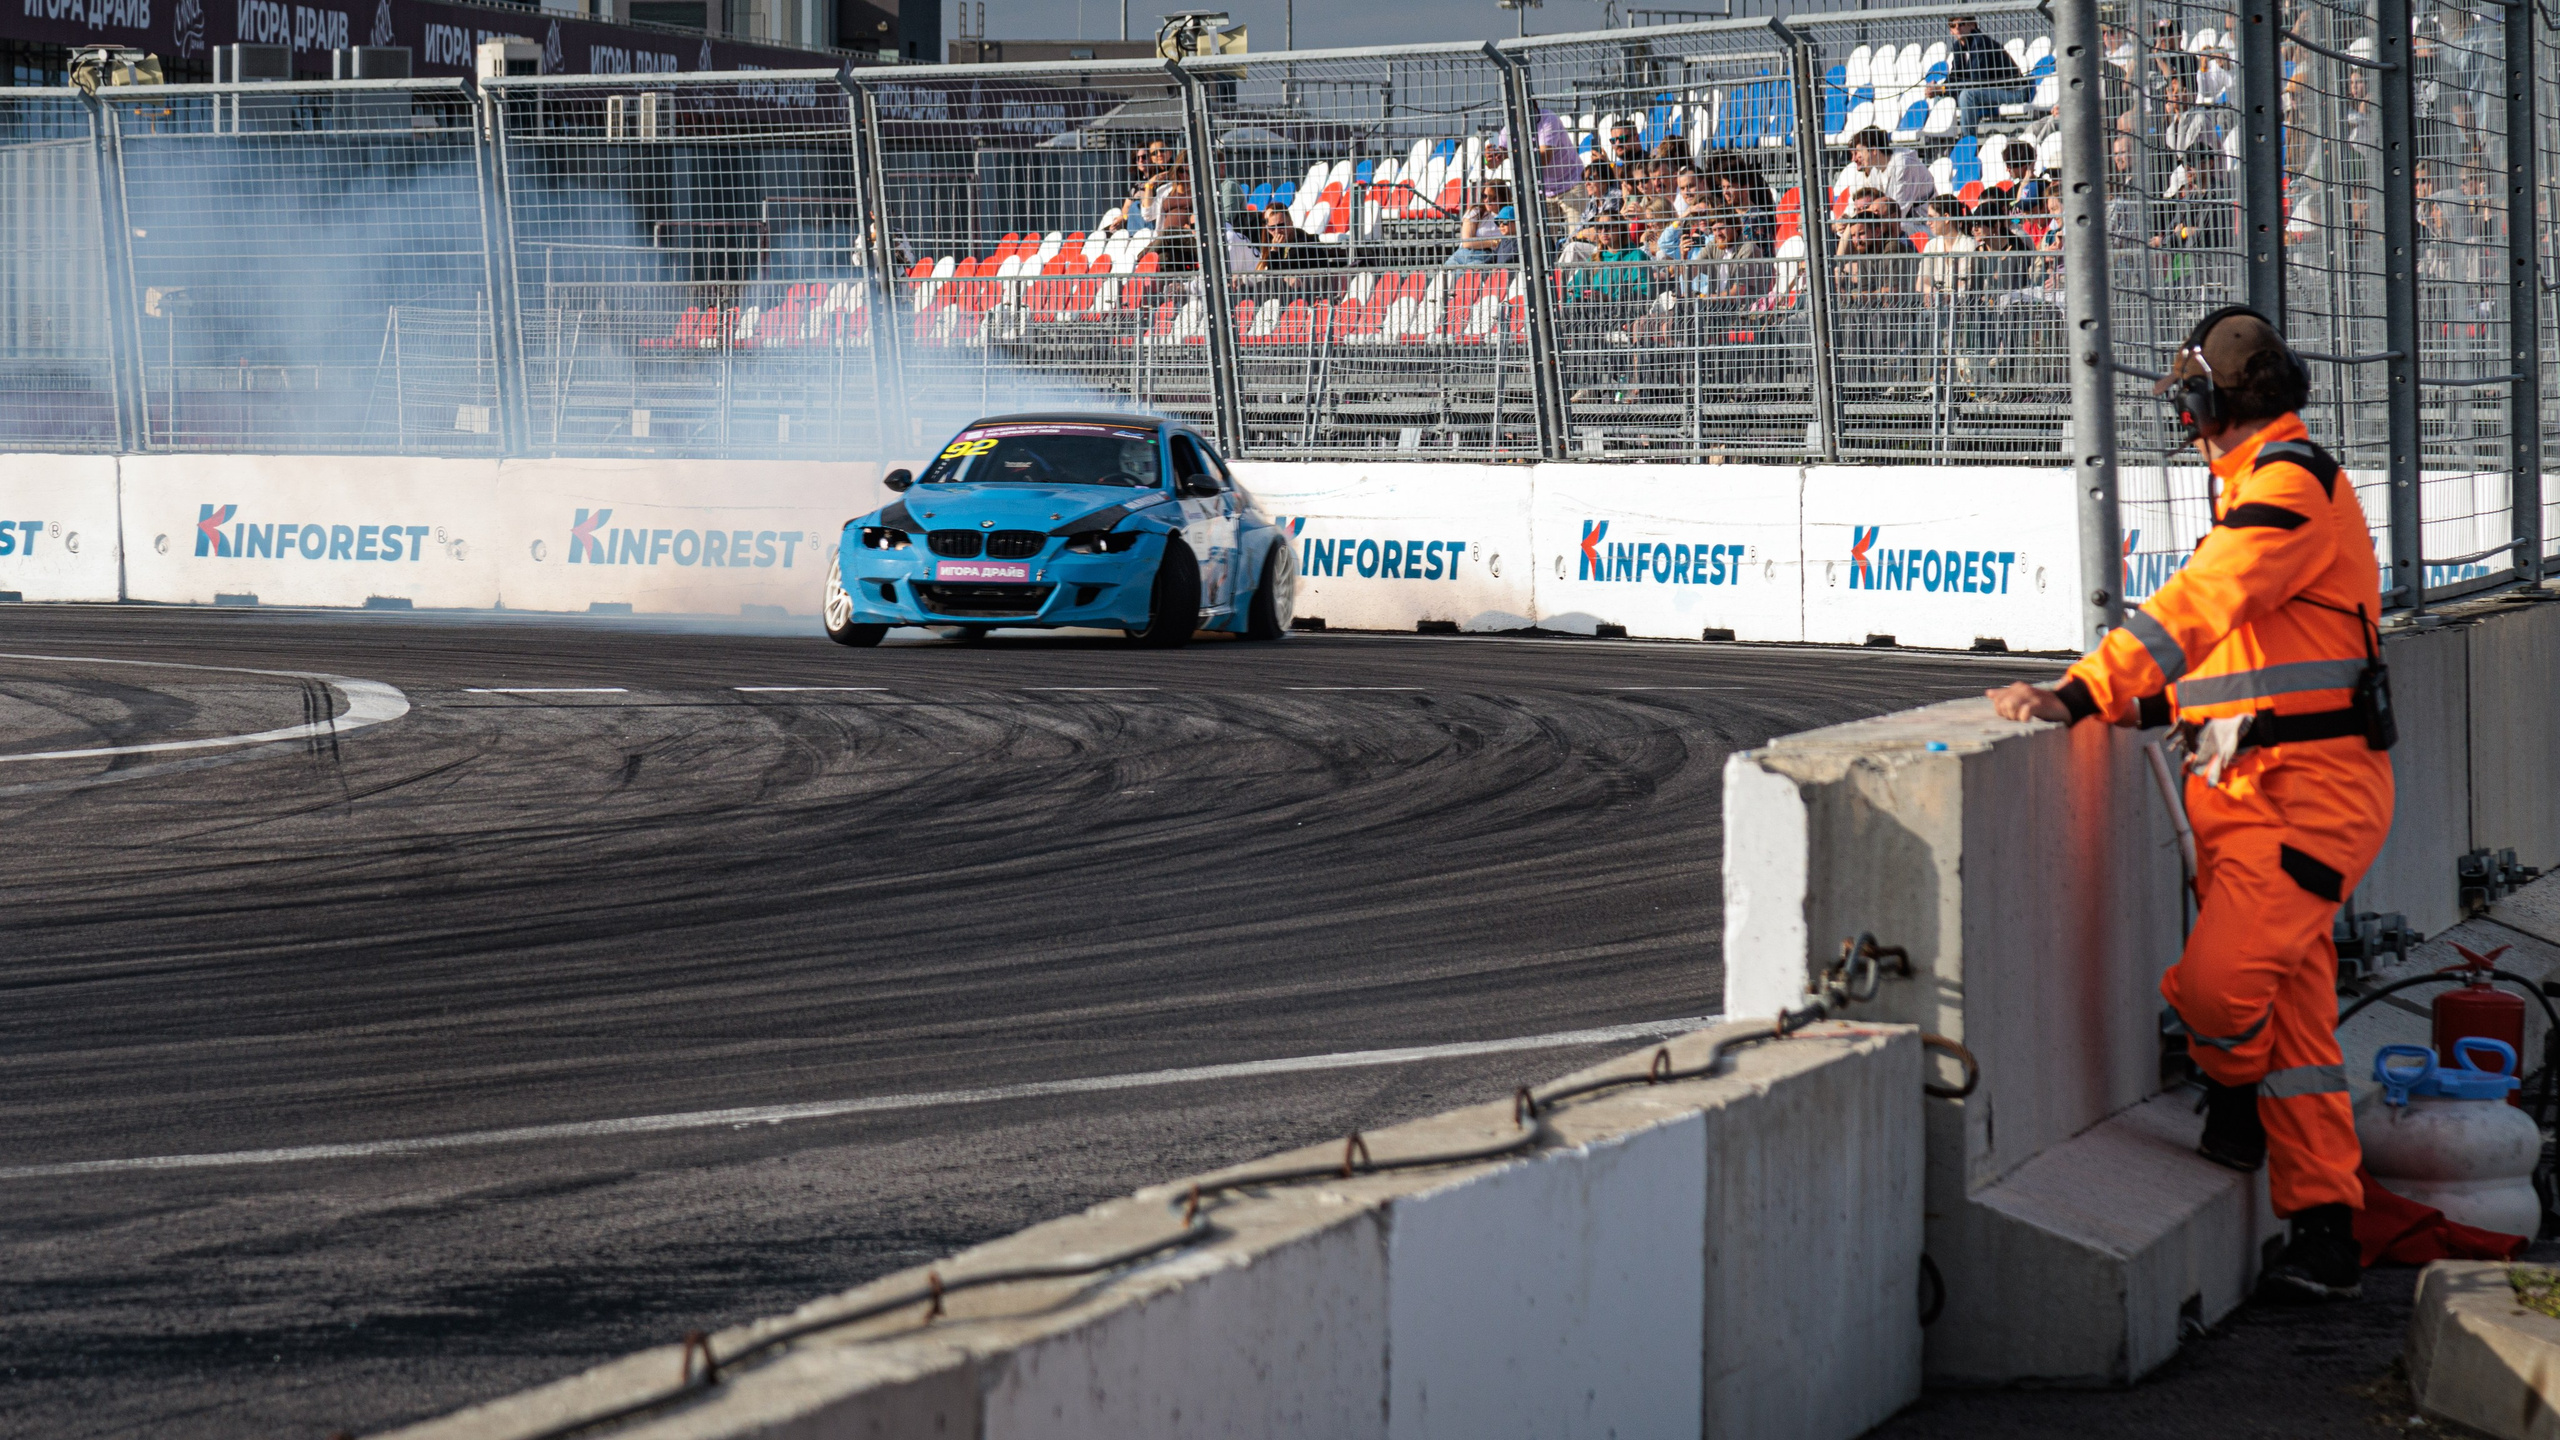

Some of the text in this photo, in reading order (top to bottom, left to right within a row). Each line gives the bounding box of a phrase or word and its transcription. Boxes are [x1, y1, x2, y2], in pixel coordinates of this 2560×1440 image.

[238, 0, 291, 45] ИГОРА
[425, 23, 472, 67] ИГОРА
[941, 438, 999, 460] 92
[194, 504, 429, 561] KINFOREST
[568, 508, 803, 568] KINFOREST
[1579, 520, 1745, 585] KINFOREST
[940, 566, 1025, 578] ИГОРА ДРАЙВ
[1849, 525, 2015, 594] KINFOREST
